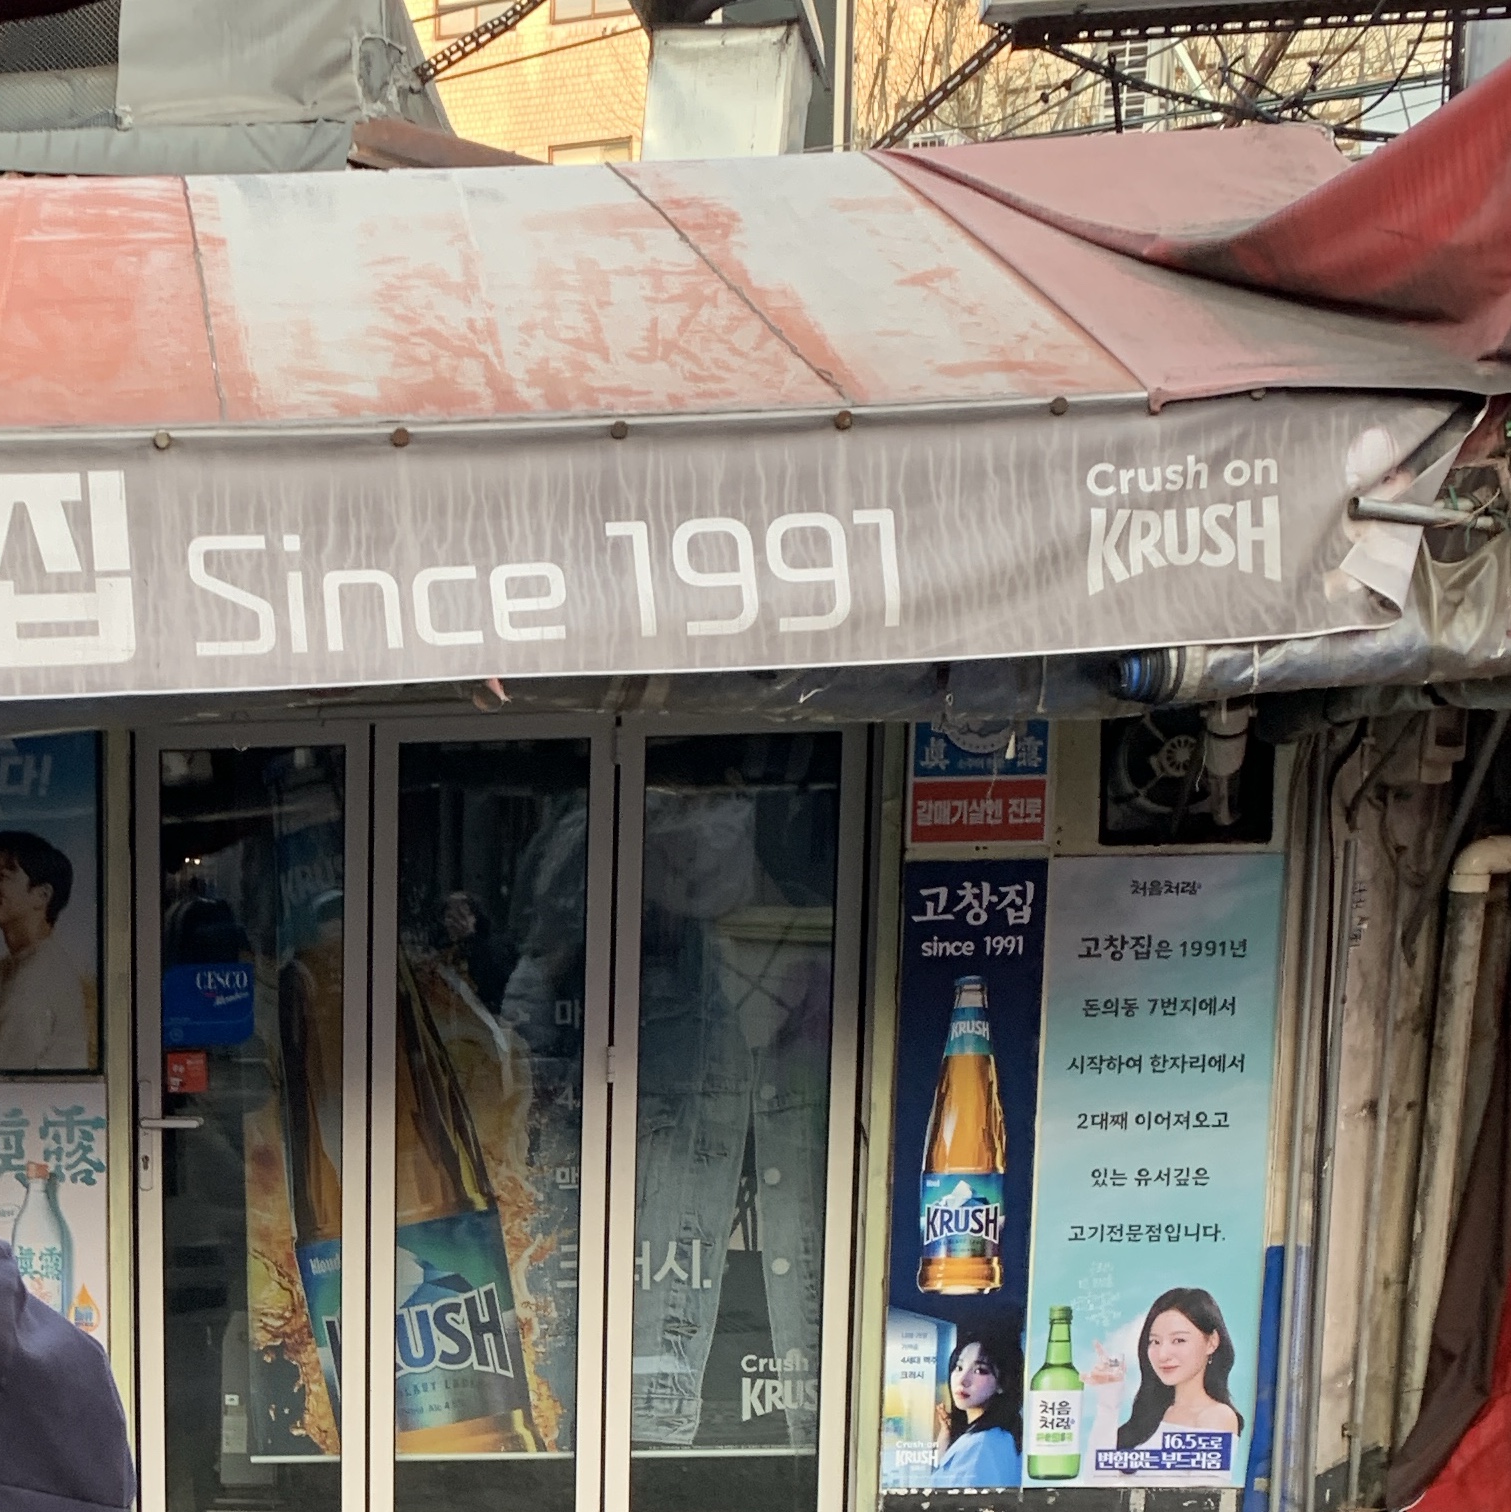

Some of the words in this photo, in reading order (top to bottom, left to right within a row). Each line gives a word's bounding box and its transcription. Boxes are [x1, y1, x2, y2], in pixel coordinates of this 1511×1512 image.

[1086, 455, 1211, 499] Crush
[1222, 454, 1281, 488] on
[1085, 493, 1283, 597] KRUSH
[187, 534, 567, 657] Since
[605, 507, 901, 637] 1991
[916, 798, 1004, 827] 갈매기살엔
[1008, 797, 1043, 825] 진로
[1130, 879, 1198, 897] 처음처럼
[910, 880, 1035, 926] 고창집
[921, 936, 975, 957] since
[984, 935, 1025, 956] 1991
[1077, 934, 1174, 962] 고창집은
[1179, 937, 1248, 959] 1991년
[1082, 997, 1140, 1018] 돈의동
[1148, 997, 1237, 1017] 7번지에서
[950, 1020, 990, 1041] KRUSH
[1066, 1054, 1143, 1074] 시작하여
[1150, 1053, 1246, 1075] 한자리에서
[1076, 1110, 1129, 1131] 2대째
[1134, 1110, 1231, 1131] 이어져오고
[1090, 1167, 1128, 1188] 있는
[1133, 1167, 1211, 1188] 유서깊은
[923, 1202, 1001, 1246] KRUSH
[1067, 1224, 1227, 1244] 고기전문점입니다.
[1039, 1399, 1072, 1416] 처음
[1039, 1416, 1072, 1430] 처럼
[1163, 1433, 1224, 1450] 16.5도로
[895, 1449, 939, 1468] KRUSH
[1097, 1451, 1160, 1469] 변함없는
[1160, 1451, 1223, 1469] 부드러움
